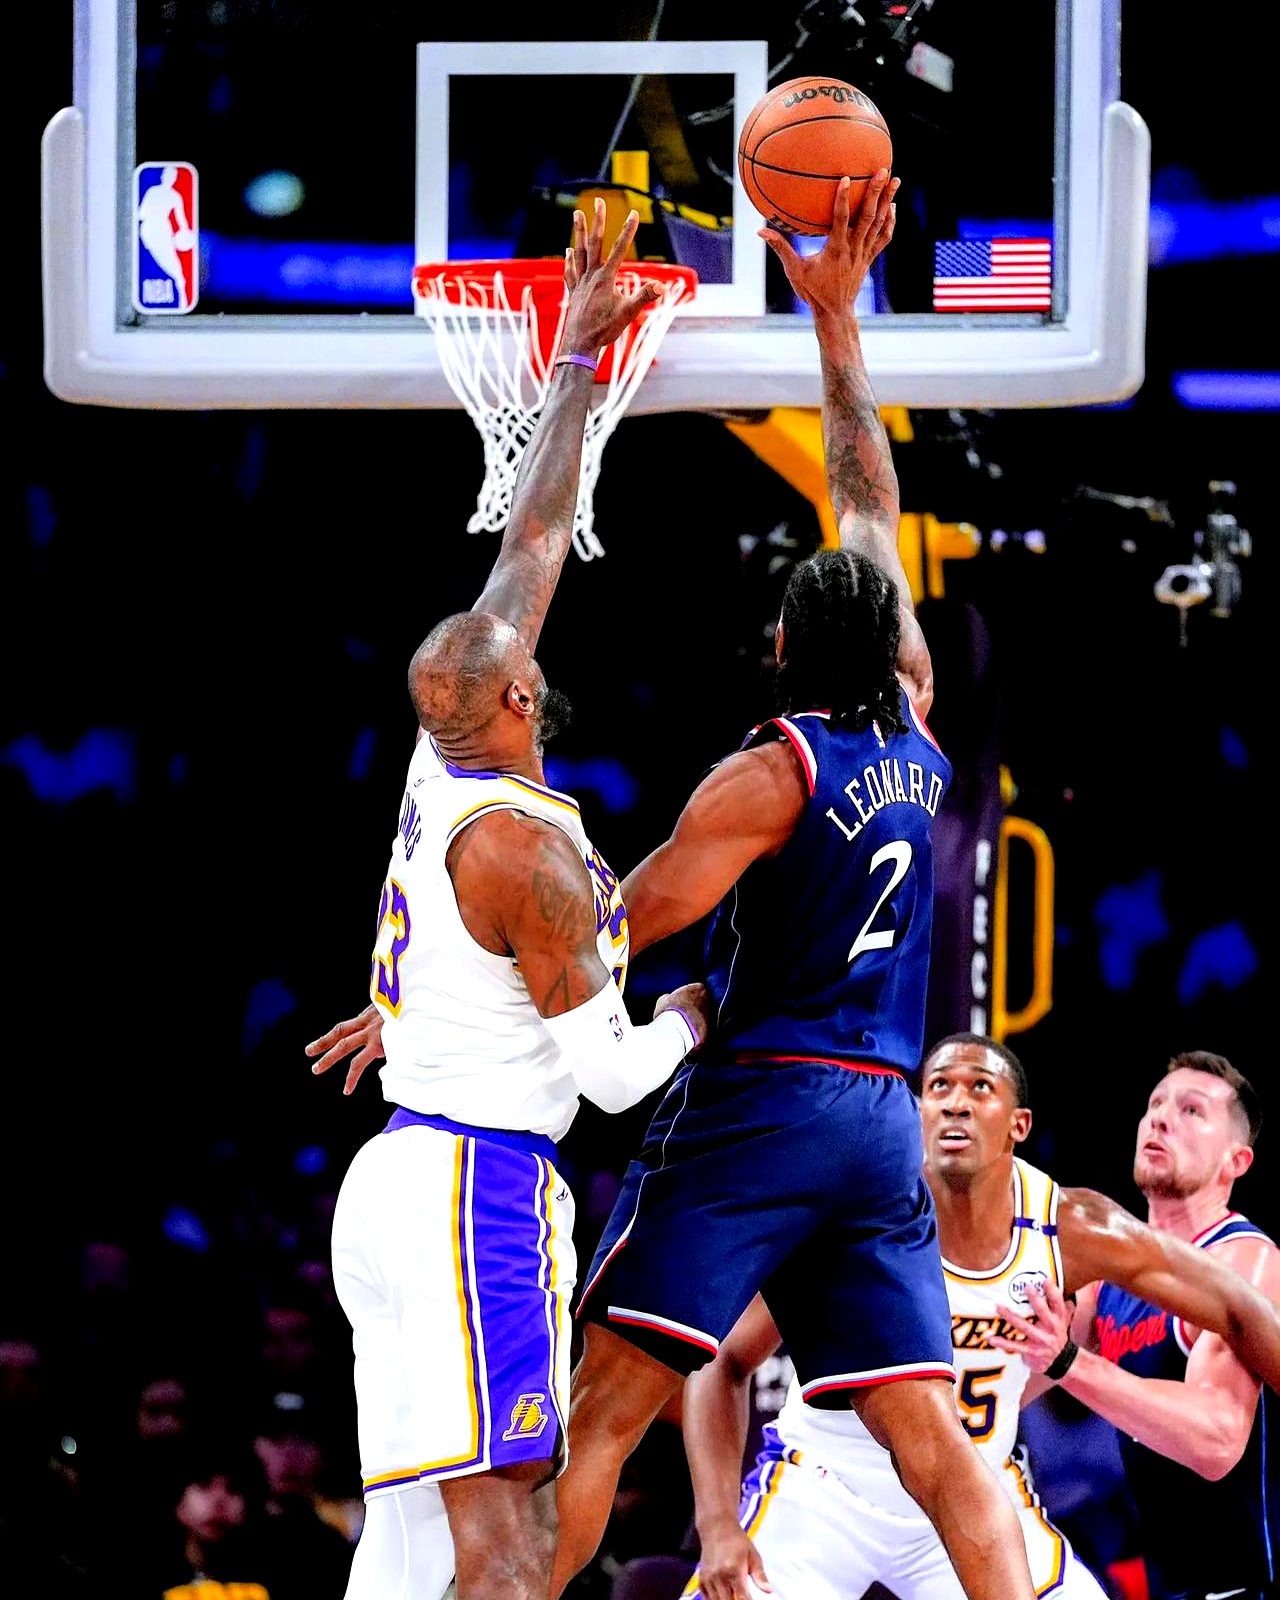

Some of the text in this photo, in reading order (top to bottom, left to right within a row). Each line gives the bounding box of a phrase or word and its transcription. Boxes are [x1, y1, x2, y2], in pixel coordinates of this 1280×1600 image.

[826, 758, 943, 841] LEONARD
[847, 840, 912, 963] 2
[957, 1366, 1007, 1443] 5
